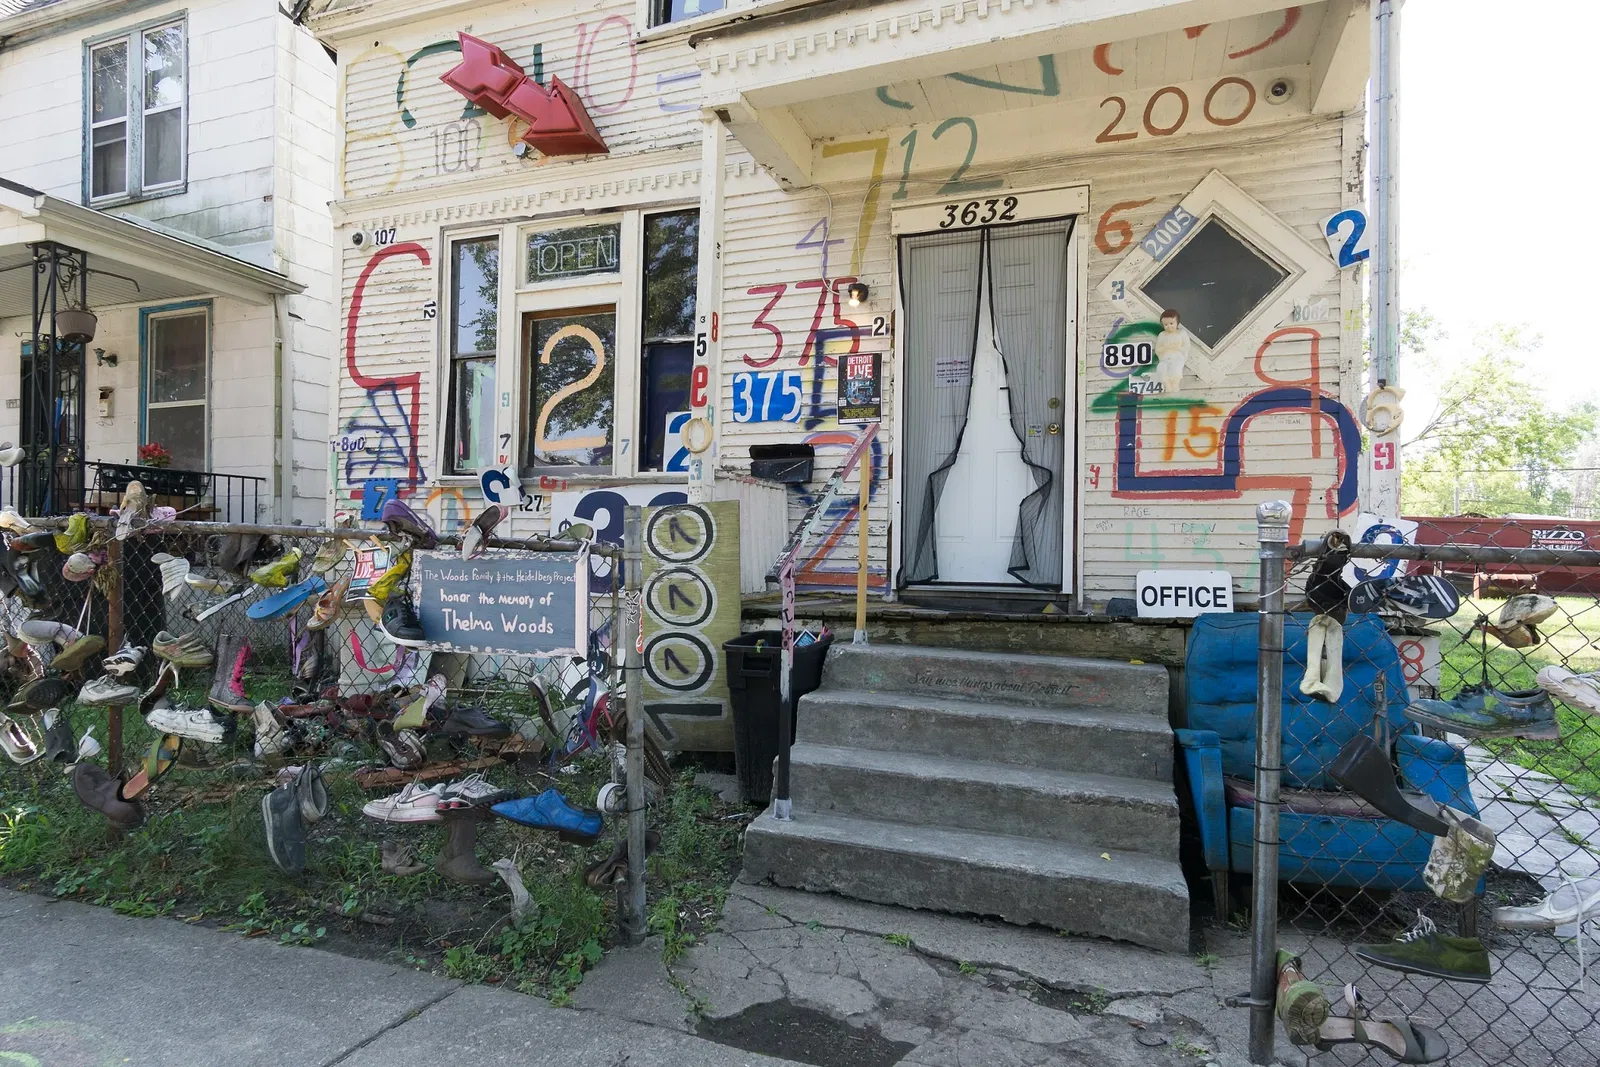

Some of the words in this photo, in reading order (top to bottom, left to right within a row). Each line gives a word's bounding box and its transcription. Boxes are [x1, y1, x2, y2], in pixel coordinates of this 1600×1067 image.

[573, 14, 638, 114] 10
[430, 118, 484, 176] 100
[939, 196, 1019, 229] 3632
[374, 228, 396, 246] 107
[1094, 197, 1157, 256] 6
[1144, 206, 1194, 257] 2005
[1325, 209, 1370, 268] 2
[539, 237, 618, 272] OPEN
[742, 277, 860, 368] 375
[872, 316, 886, 336] 2
[697, 332, 707, 357] 5
[1105, 342, 1152, 367] 890
[847, 355, 873, 365] DETROIT
[847, 364, 873, 379] LIVE
[535, 324, 605, 451] 2
[733, 370, 802, 423] 375
[1129, 381, 1163, 394] 5744
[499, 433, 512, 450] 7
[620, 438, 631, 455] 7
[1160, 405, 1223, 463] 15
[372, 486, 389, 514] 7
[1124, 507, 1150, 517] RAGE
[1532, 529, 1586, 541] RIZZO
[424, 569, 439, 581] The
[440, 568, 469, 582] Woods
[502, 572, 515, 582] the
[516, 569, 553, 584] Heidelberg
[553, 571, 576, 584] Project
[478, 592, 496, 605] the
[539, 591, 554, 606] of
[1141, 585, 1228, 608] OFFICE
[441, 608, 494, 632] Thelma
[500, 612, 554, 634] Woods
